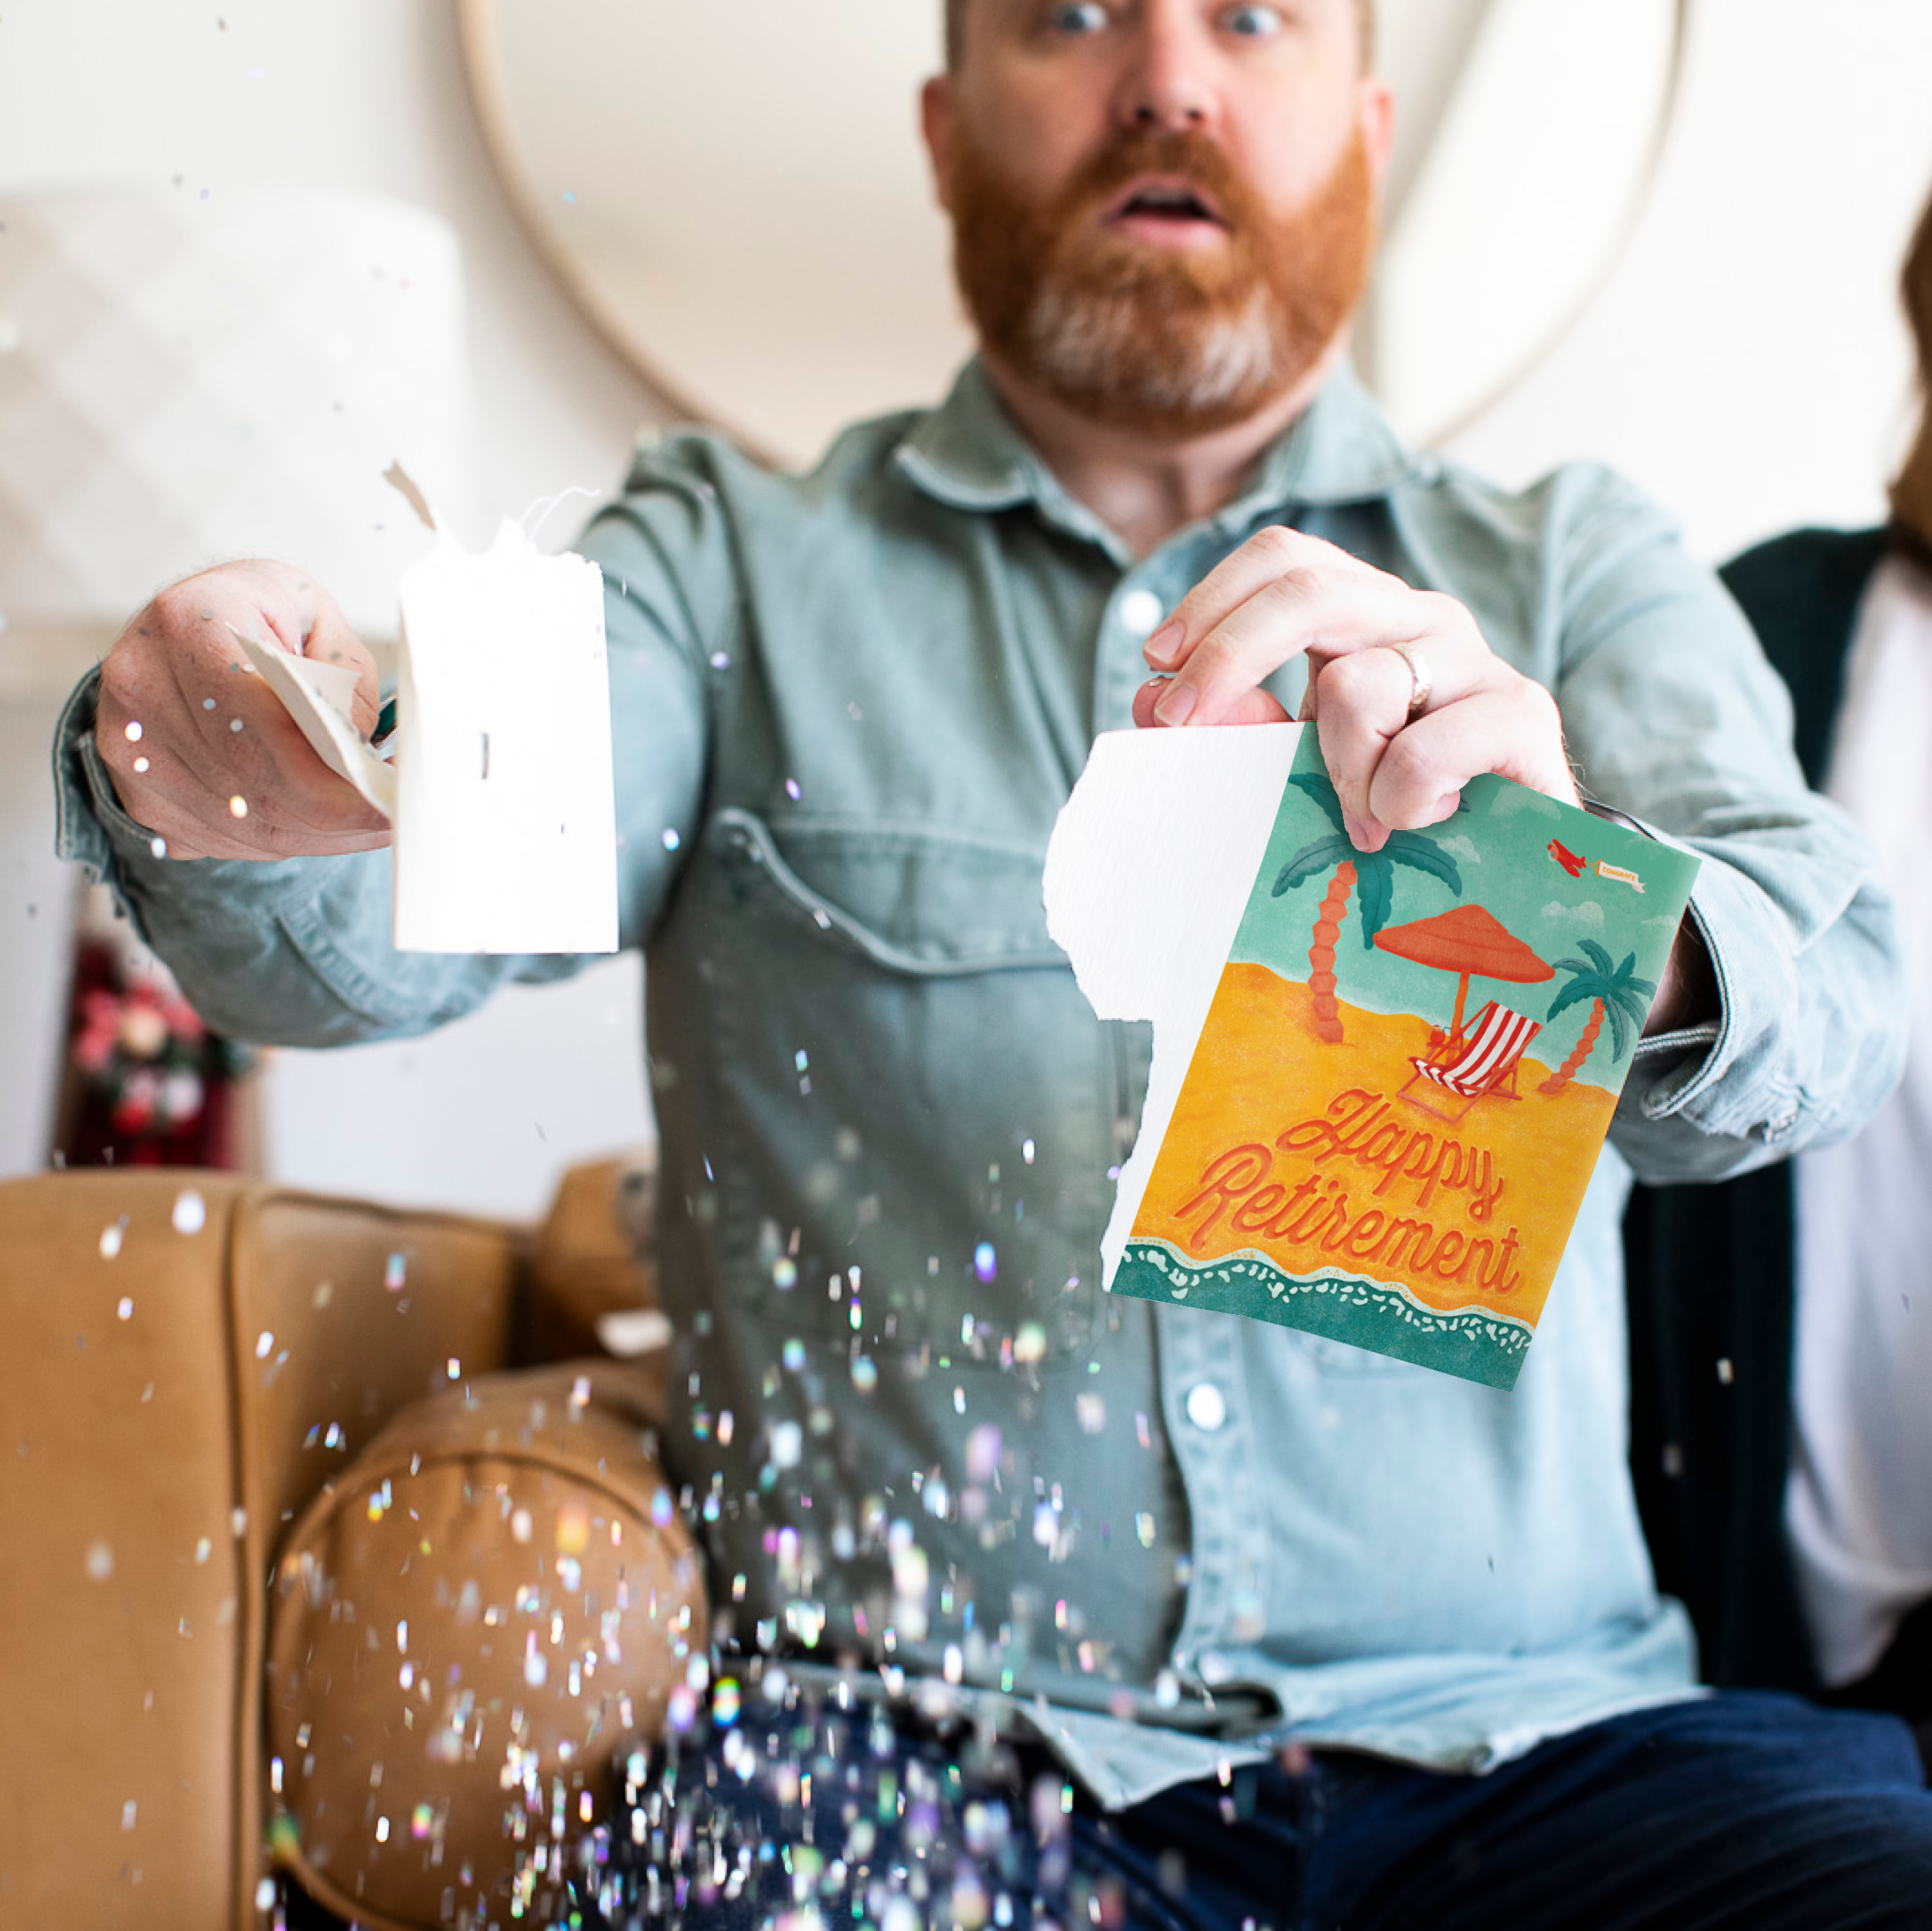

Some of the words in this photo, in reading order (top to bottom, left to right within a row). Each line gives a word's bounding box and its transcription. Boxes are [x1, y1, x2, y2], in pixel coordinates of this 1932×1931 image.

[1603, 867, 1635, 881] CONGRATS
[1175, 1144, 1520, 1294] Retirement
[1276, 1089, 1503, 1222] Happy
